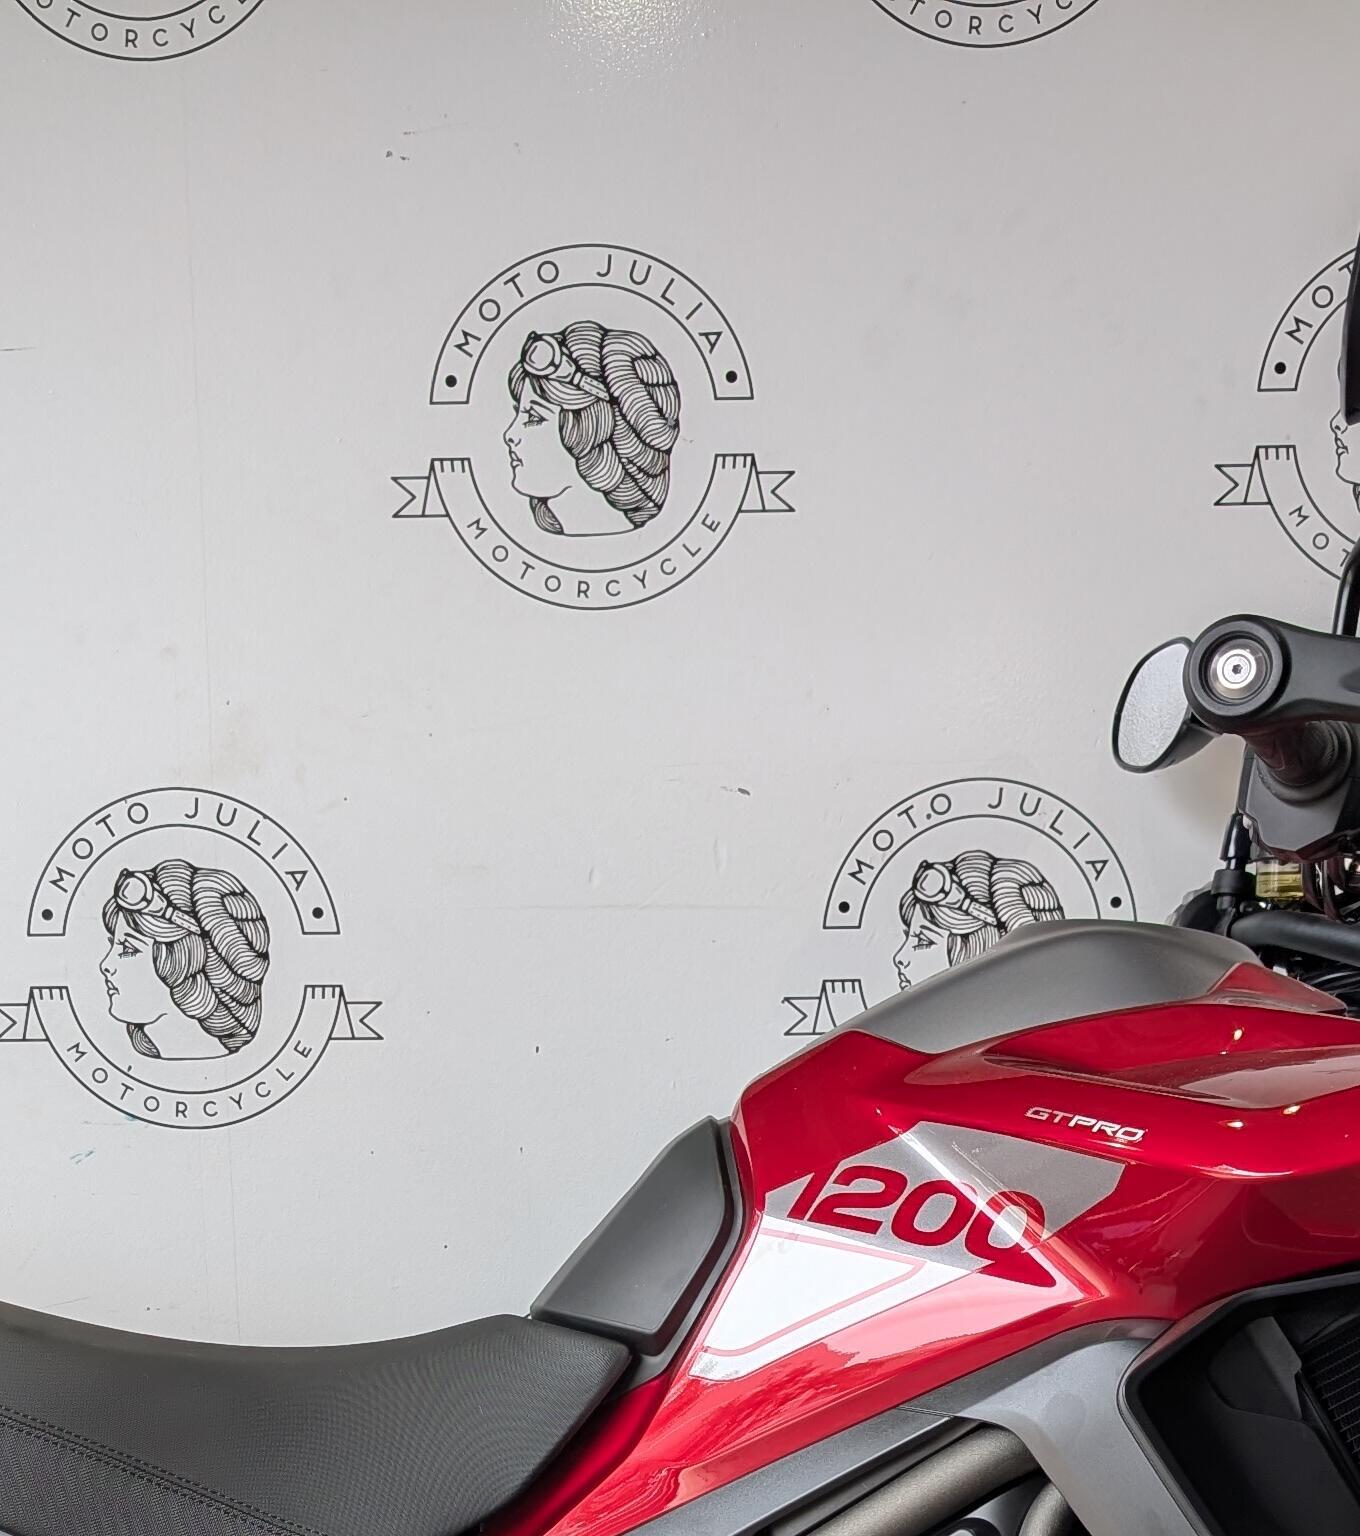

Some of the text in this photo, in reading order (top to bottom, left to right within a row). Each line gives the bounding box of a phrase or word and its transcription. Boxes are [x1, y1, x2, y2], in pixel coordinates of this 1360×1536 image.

[36, 0, 245, 48] TORCYC
[454, 254, 722, 358] MOTO JULIA
[467, 513, 721, 599] MOTORCYCLE
[49, 797, 308, 893] MOTO JULIA
[848, 787, 1109, 885] MOTO JULIA
[66, 1040, 314, 1119] MOTORCYCLE
[786, 1165, 1047, 1264] 1200
